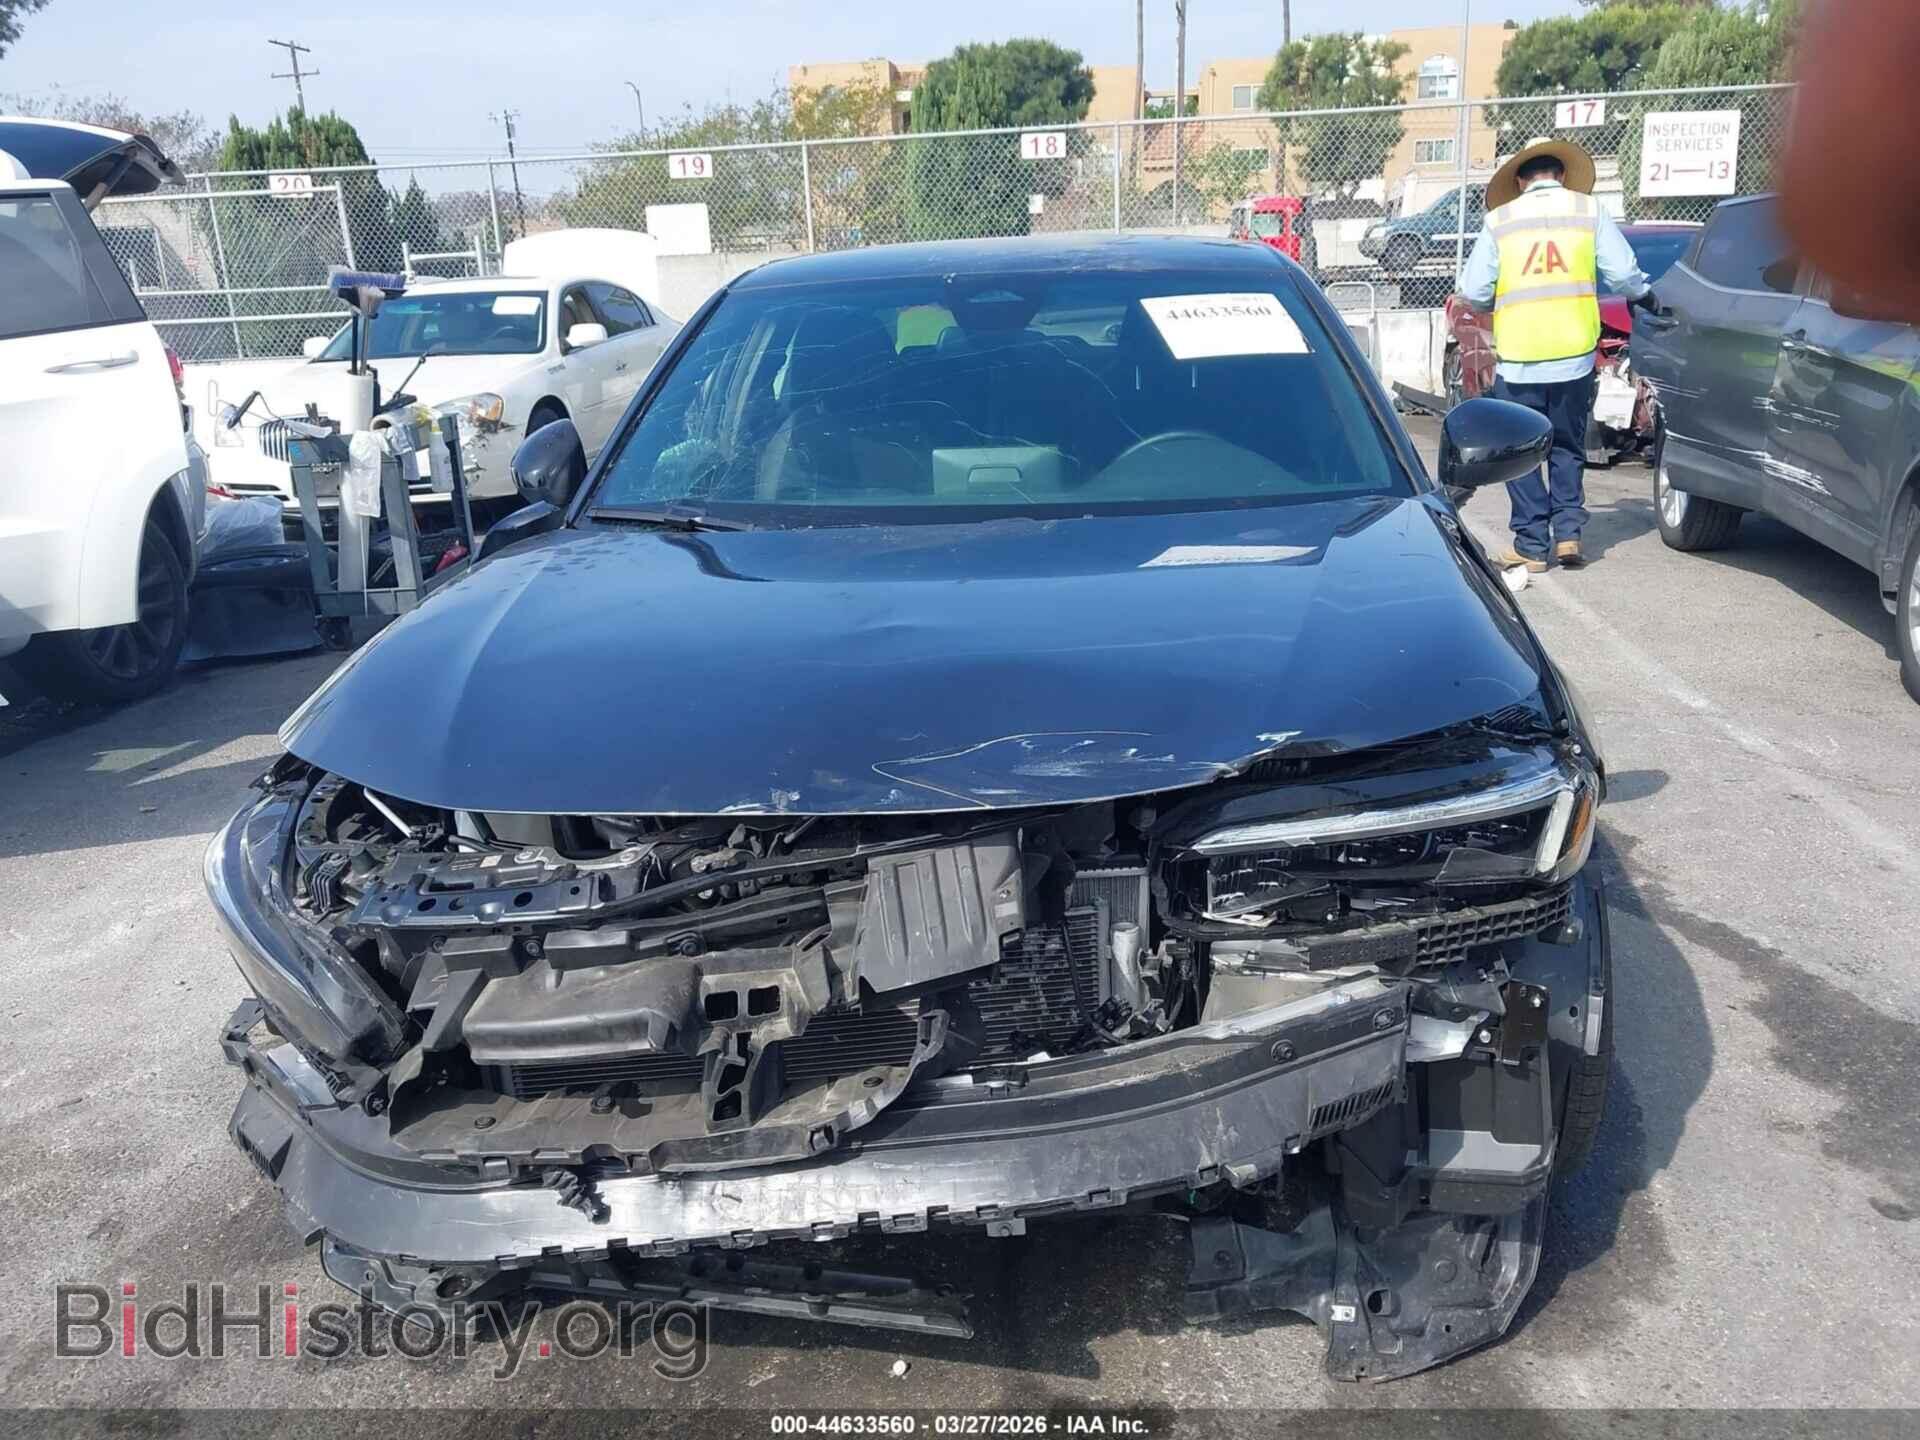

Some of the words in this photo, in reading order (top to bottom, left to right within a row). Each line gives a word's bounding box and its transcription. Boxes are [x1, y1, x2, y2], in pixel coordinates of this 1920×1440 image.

[1566, 102, 1598, 125] 17
[1647, 122, 1731, 137] INSPECTION
[1029, 135, 1058, 156] 18
[1655, 137, 1724, 152] SERVICES
[677, 155, 705, 177] 19
[277, 176, 306, 191] 20
[1166, 305, 1273, 321] 44633560
